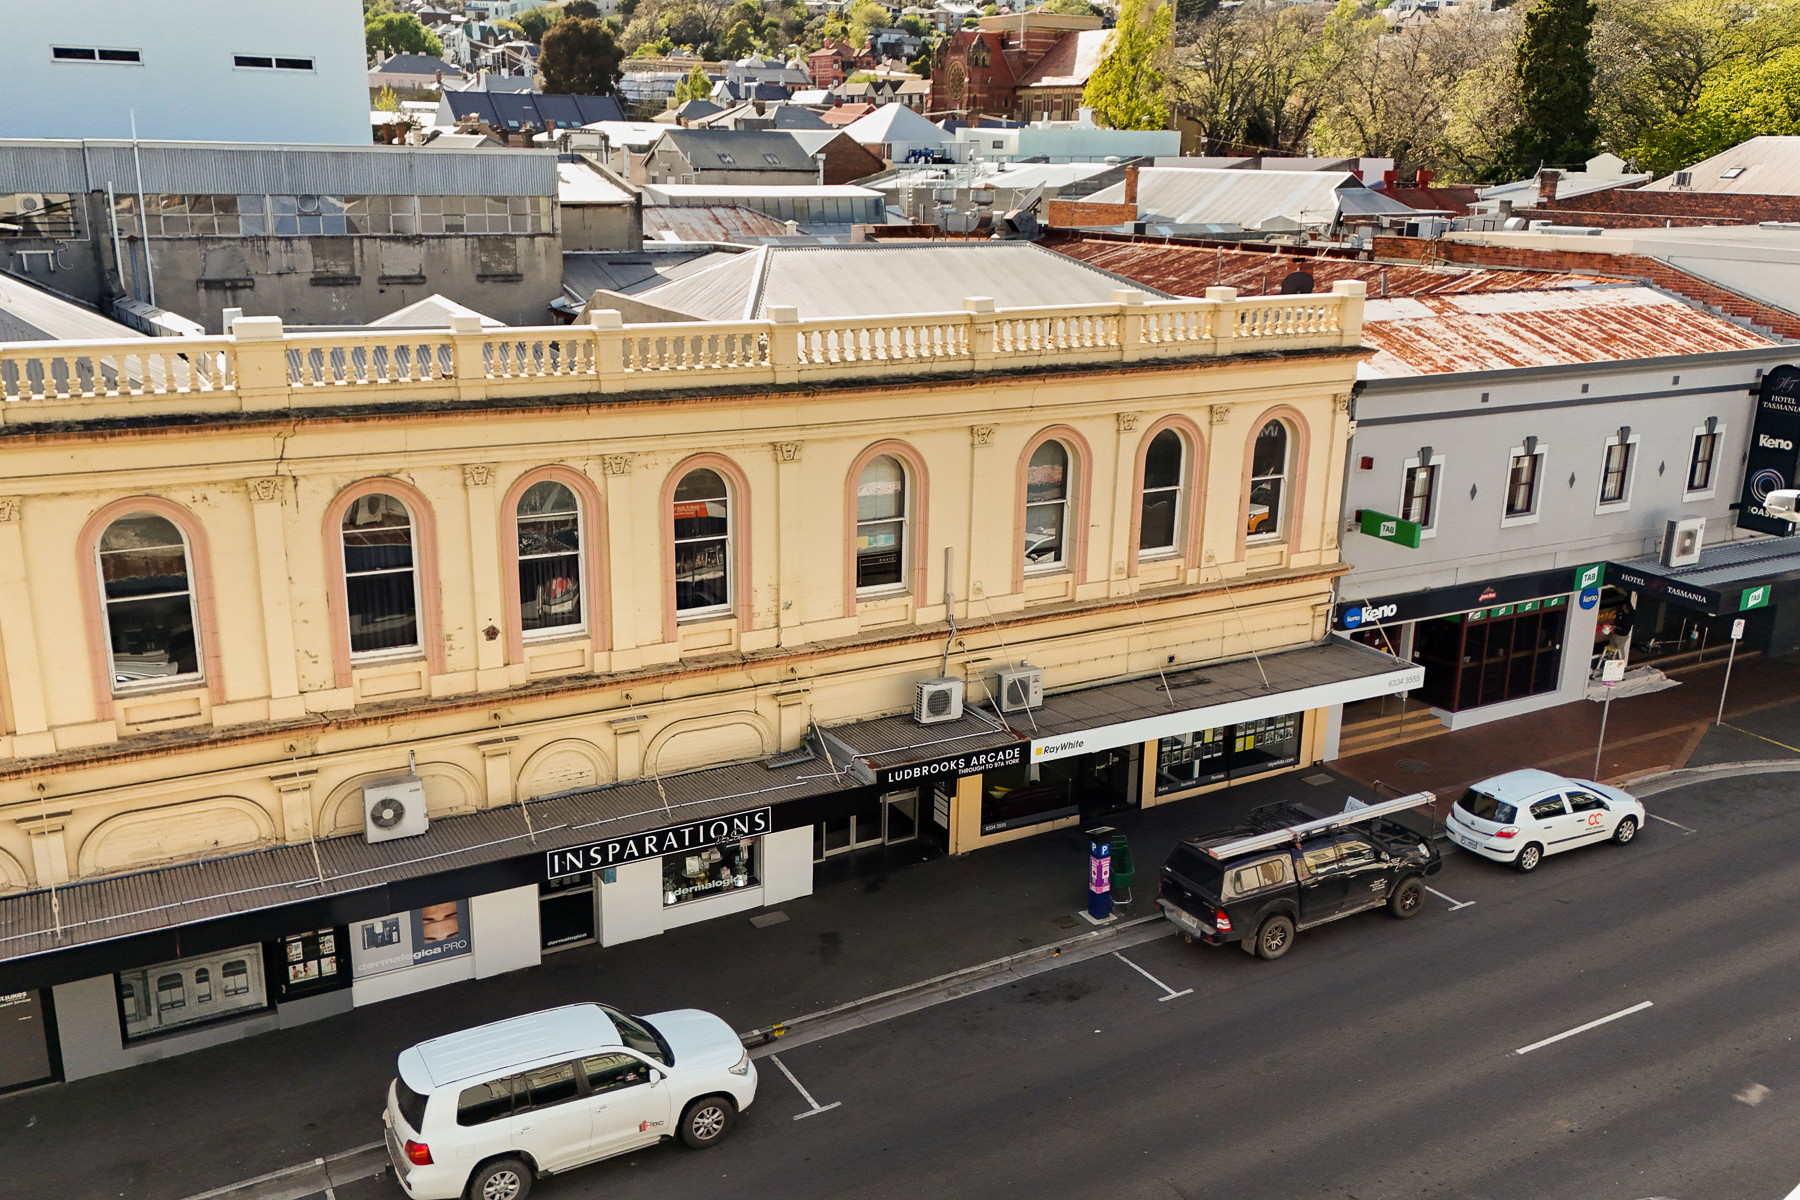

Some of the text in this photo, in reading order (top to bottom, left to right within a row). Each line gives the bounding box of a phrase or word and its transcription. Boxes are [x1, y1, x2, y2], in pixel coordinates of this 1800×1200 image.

[1771, 395, 1796, 405] HOTEL
[1382, 523, 1395, 534] TAB
[1584, 573, 1596, 582] TAB
[1621, 573, 1645, 586] HOTEL
[1667, 586, 1707, 603] TASMANIA
[1750, 593, 1761, 602] TAB
[1388, 674, 1420, 688] 6334 3555
[888, 747, 1020, 783] LUDBROOKS ARCADE
[958, 765, 985, 775] THROUGH
[553, 812, 766, 874] INSPARATIONS
[1091, 842, 1097, 852] P
[1102, 845, 1108, 855] P
[357, 939, 468, 972] dermalogica PRO
